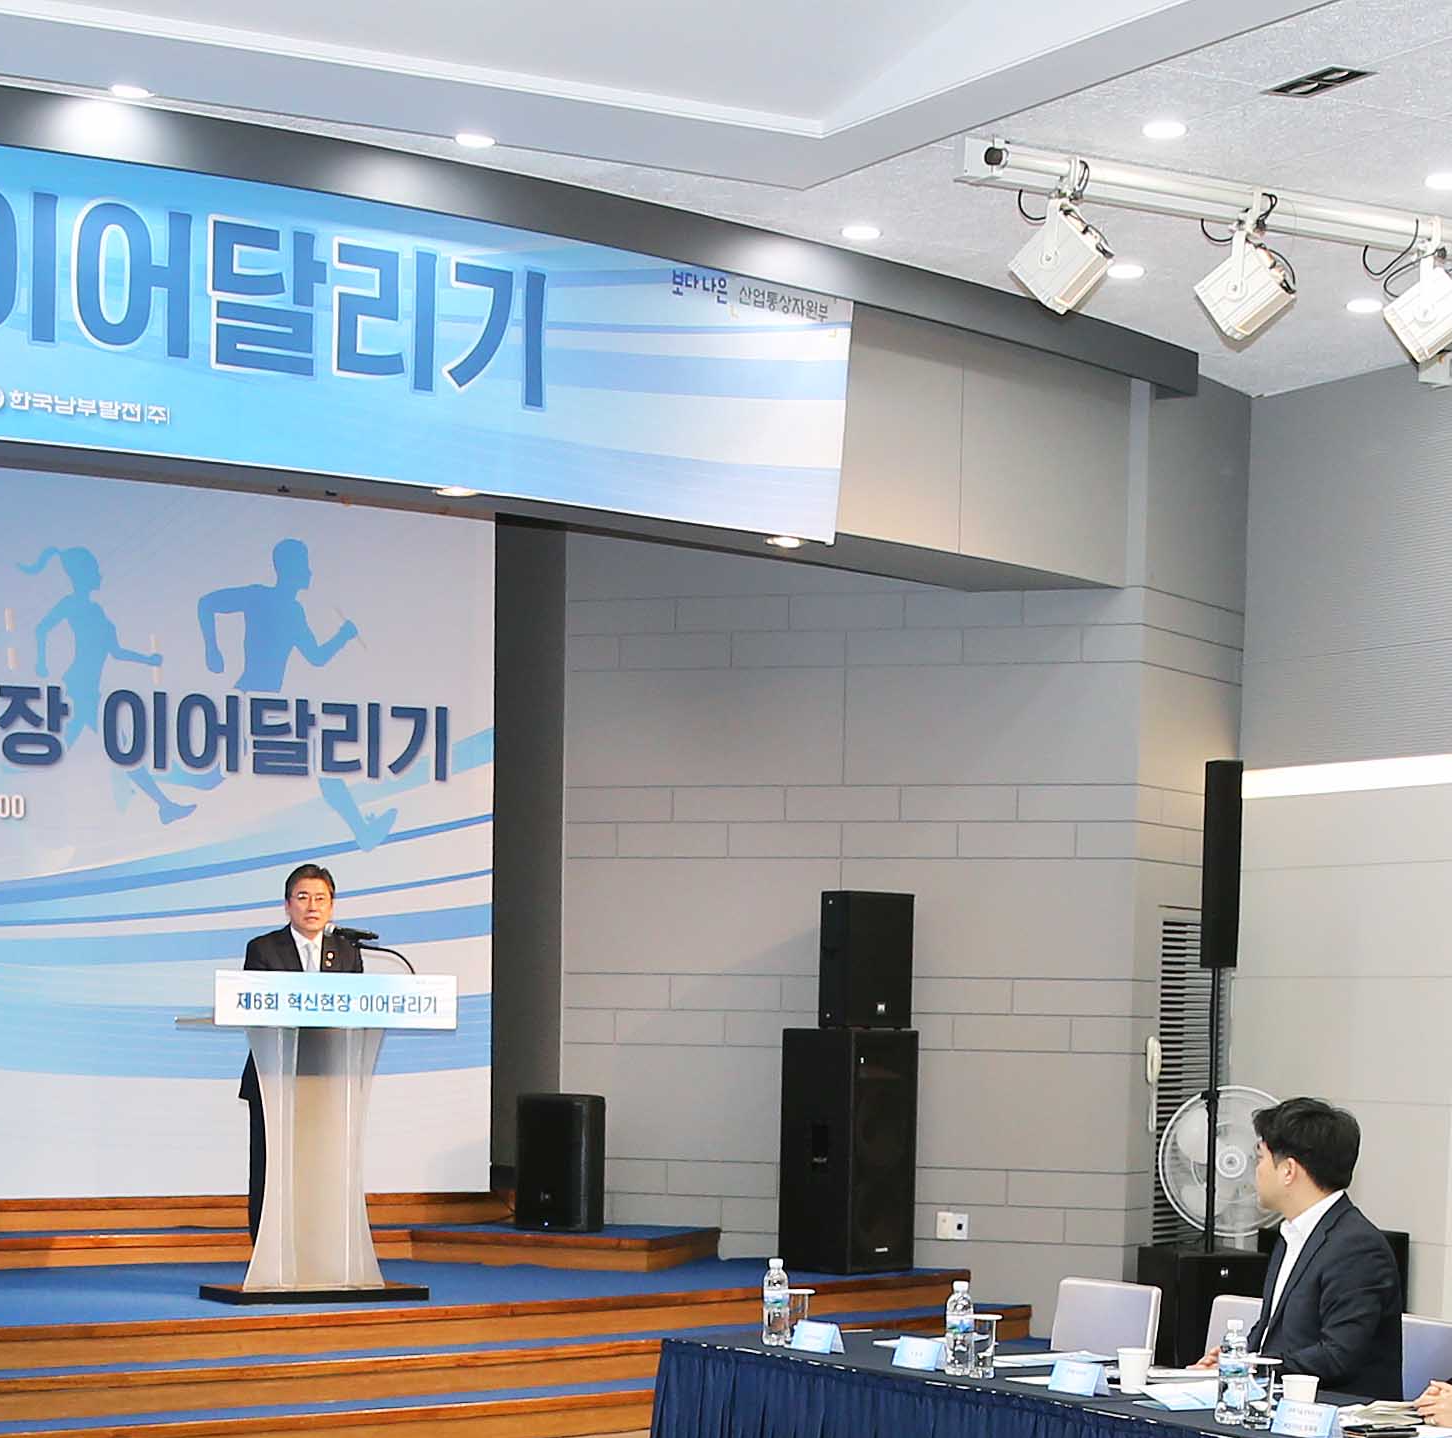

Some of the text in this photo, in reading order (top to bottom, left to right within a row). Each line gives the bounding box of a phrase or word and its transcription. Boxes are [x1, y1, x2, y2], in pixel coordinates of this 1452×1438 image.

[739, 286, 829, 322] 산업통상자원부
[103, 688, 449, 782] 이어달리기
[236, 992, 437, 1014] 제6회 혁신현장 이어달리기
